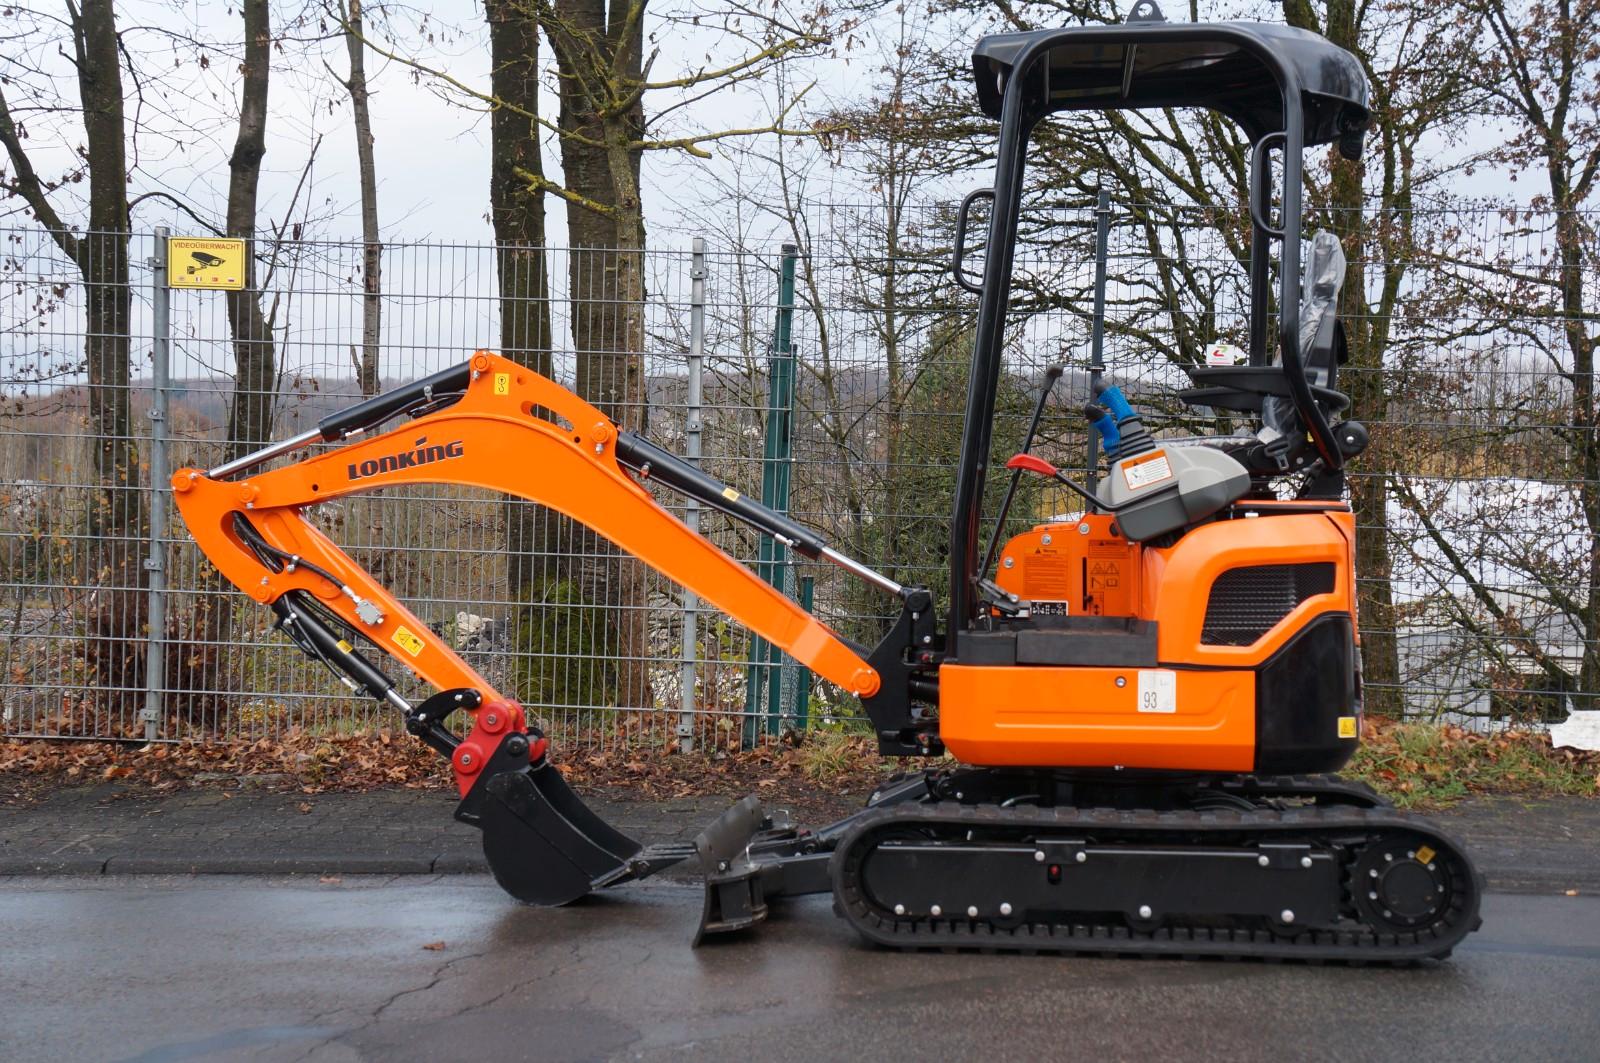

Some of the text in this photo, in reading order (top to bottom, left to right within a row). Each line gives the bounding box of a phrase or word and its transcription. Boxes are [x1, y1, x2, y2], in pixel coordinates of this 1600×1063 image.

[174, 241, 240, 250] VIDEOÜBERWACHT
[347, 436, 464, 480] LONKING
[1143, 691, 1158, 709] 93
